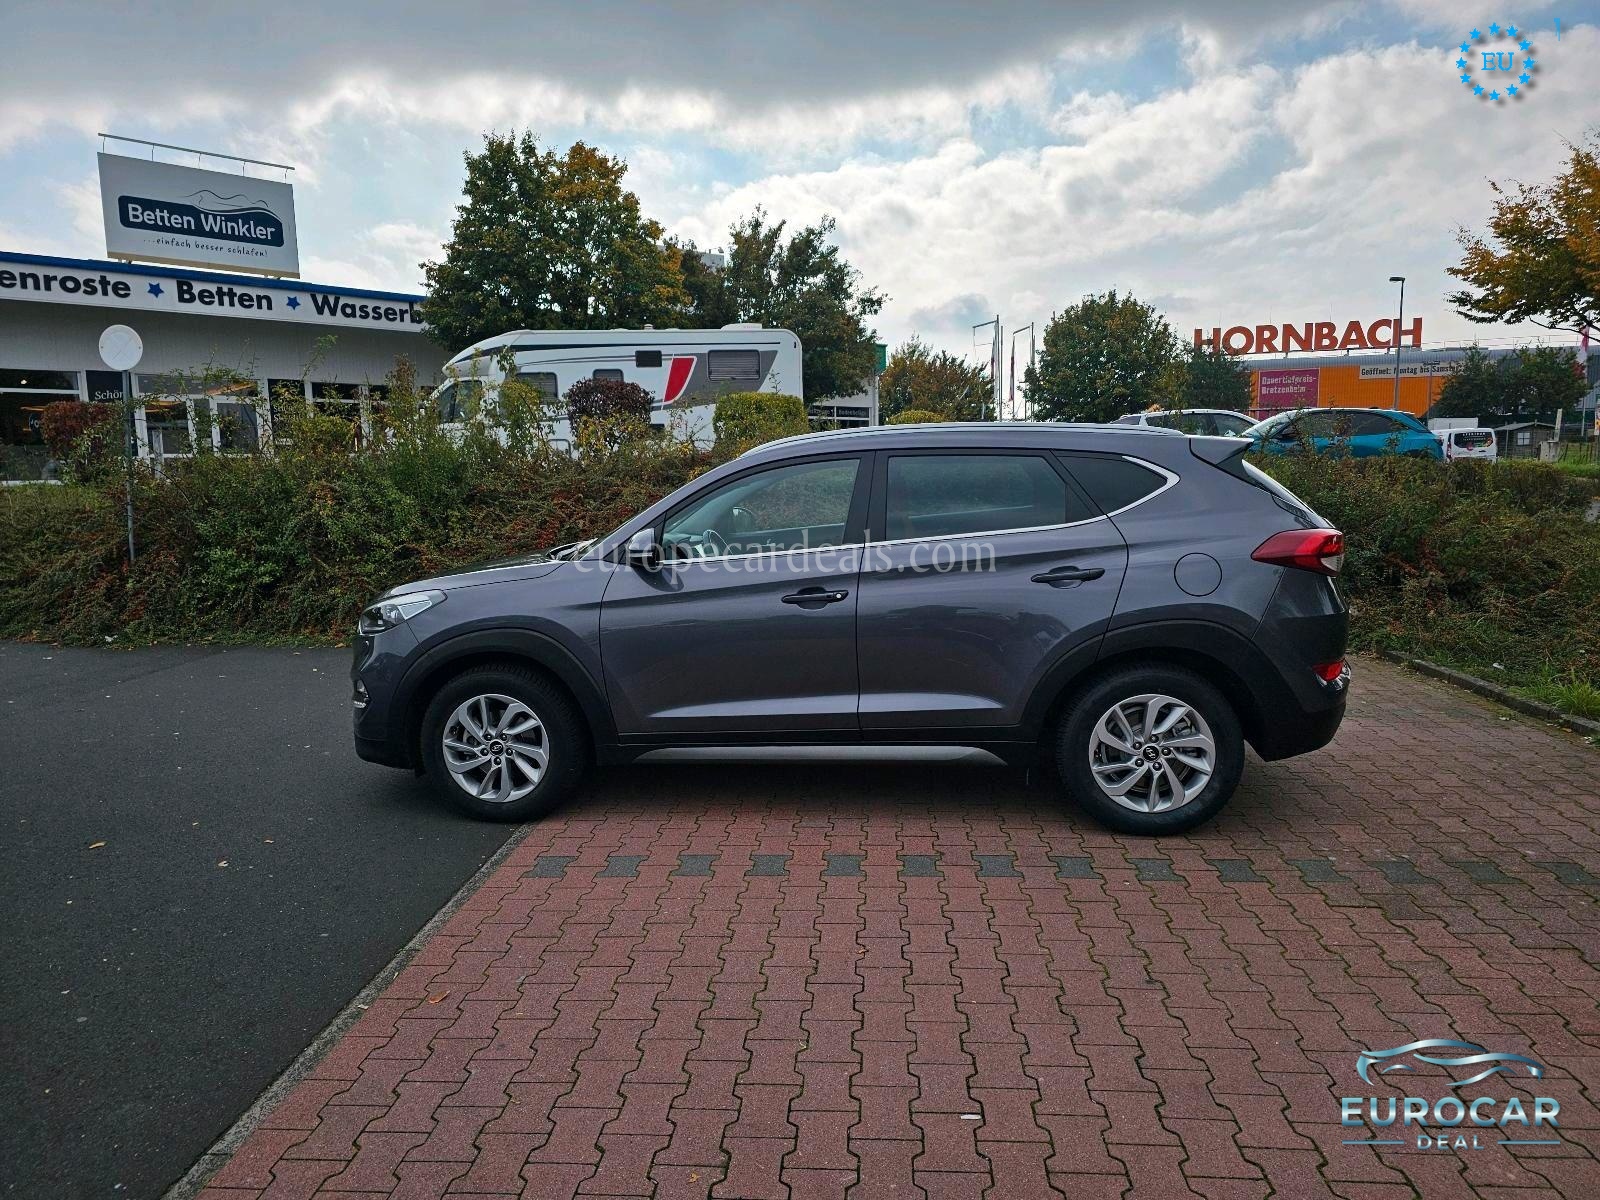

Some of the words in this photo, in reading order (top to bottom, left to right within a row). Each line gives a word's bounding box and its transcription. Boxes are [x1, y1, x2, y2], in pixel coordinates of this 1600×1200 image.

[127, 203, 196, 230] Betten
[200, 213, 276, 240] Winkler
[194, 241, 224, 252] besser
[0, 269, 131, 299] enroste
[176, 279, 273, 311] Betten
[1194, 317, 1423, 355] HORNBACH
